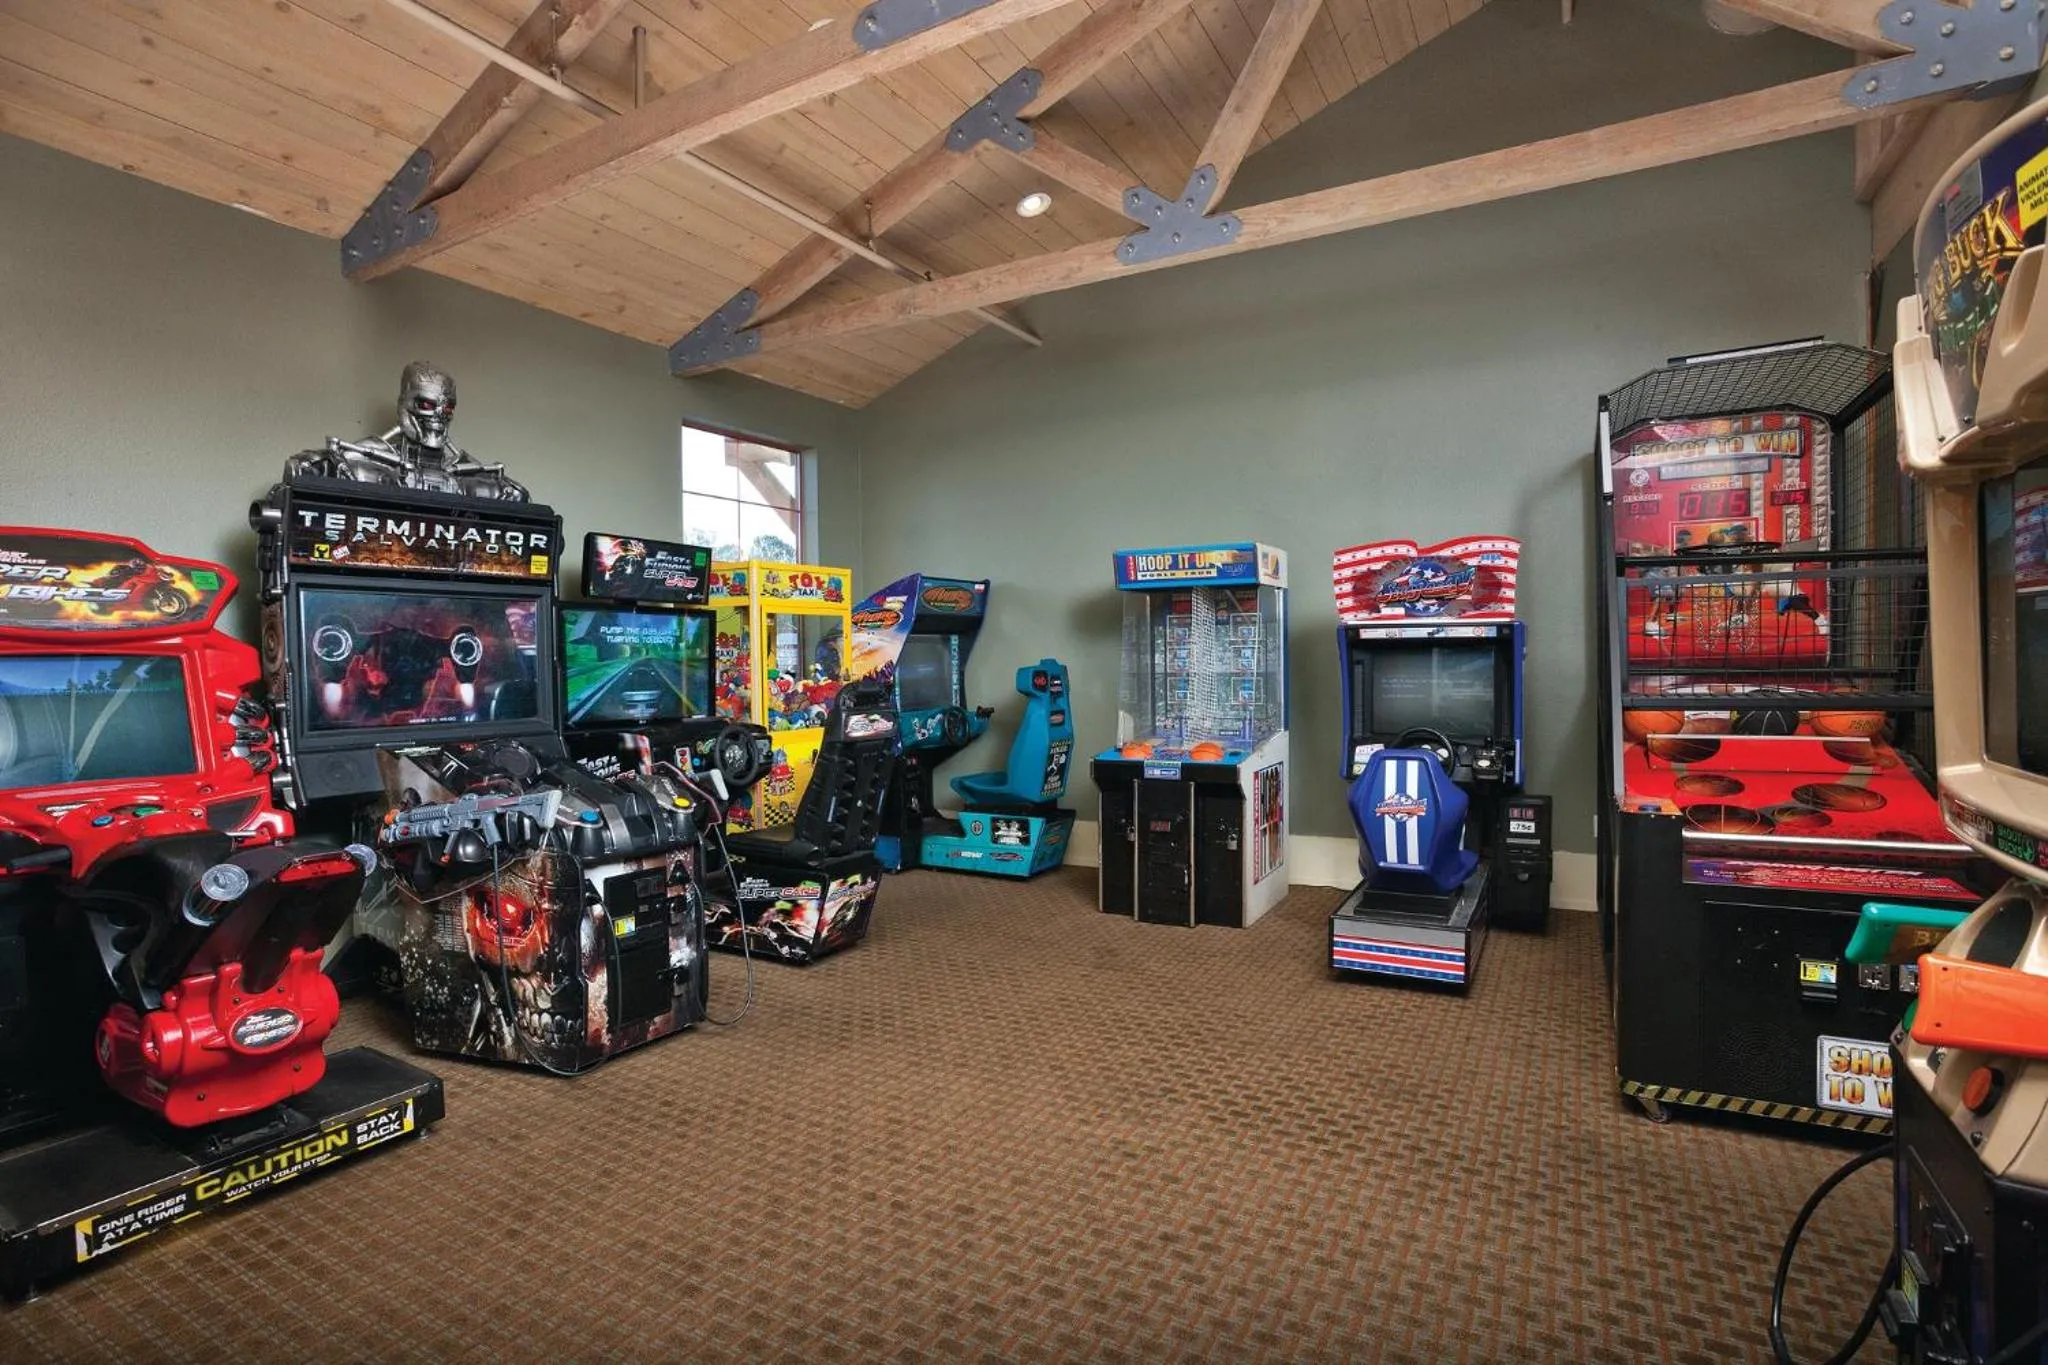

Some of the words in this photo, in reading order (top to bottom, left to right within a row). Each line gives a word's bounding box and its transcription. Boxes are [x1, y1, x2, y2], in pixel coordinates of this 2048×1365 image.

[1944, 186, 2026, 289] BUCK
[1753, 430, 1798, 453] WIN
[298, 510, 549, 549] TERMINATOR
[325, 530, 523, 556] SALVATION
[1139, 555, 1172, 571] HOOP
[1179, 553, 1191, 569] IT
[799, 587, 818, 597] TAXI
[1825, 1073, 1866, 1104] TO
[356, 1110, 399, 1134] STAY
[356, 1120, 401, 1145] BACK
[195, 1129, 349, 1201] CAUTION
[226, 1176, 270, 1198] WATCH
[271, 1164, 302, 1180] YOUR
[303, 1153, 331, 1169] STEP
[98, 1213, 135, 1233] ONE
[137, 1193, 187, 1218] RIDER
[102, 1226, 127, 1242] AT
[129, 1221, 142, 1232] A
[144, 1204, 185, 1224] TIME
